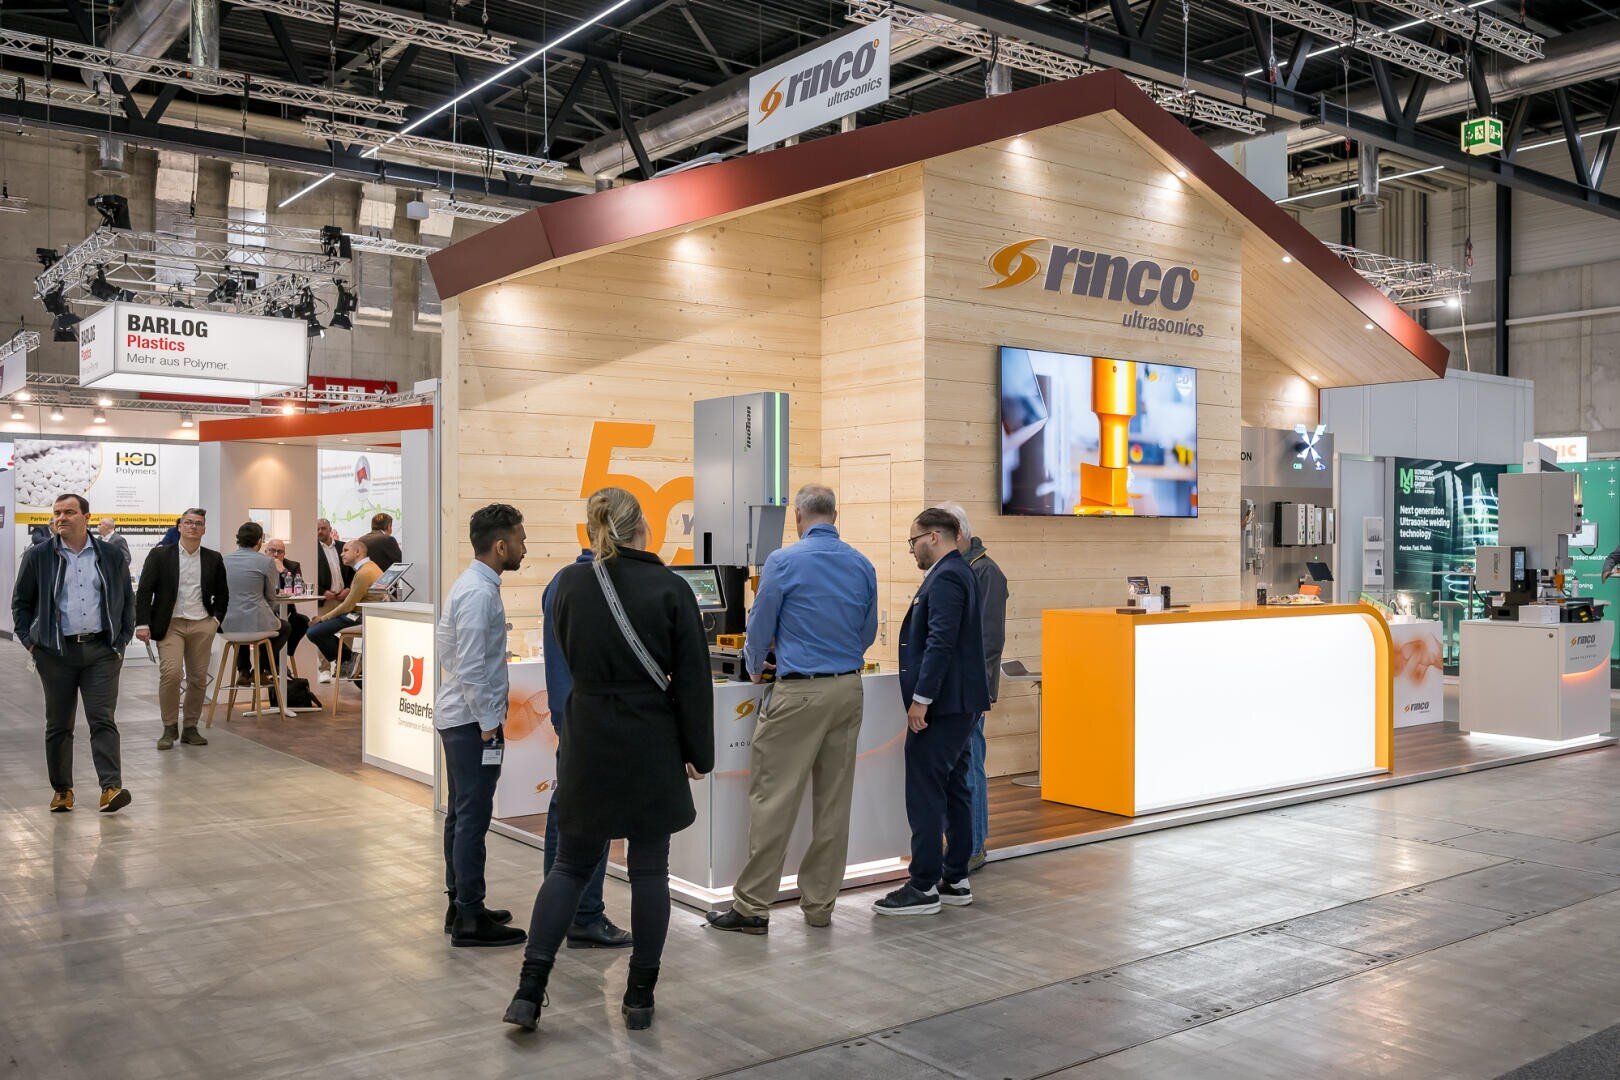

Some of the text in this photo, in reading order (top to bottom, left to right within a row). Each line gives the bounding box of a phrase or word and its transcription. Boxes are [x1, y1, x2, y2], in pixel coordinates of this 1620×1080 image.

[785, 38, 880, 108] rinco
[827, 76, 883, 107] ultrasonics
[1044, 244, 1200, 312] rinco
[127, 313, 208, 338] BARLOG
[1122, 310, 1205, 338] ultrasonics
[127, 334, 185, 352] Plastics
[126, 352, 231, 371] Mehr aus Polymer.
[115, 466, 158, 476] Polymers
[1400, 505, 1445, 517] Next generation
[1400, 517, 1451, 529] Ultrasonic welding
[1400, 529, 1432, 540] technology
[399, 697, 433, 719] Biesterfe
